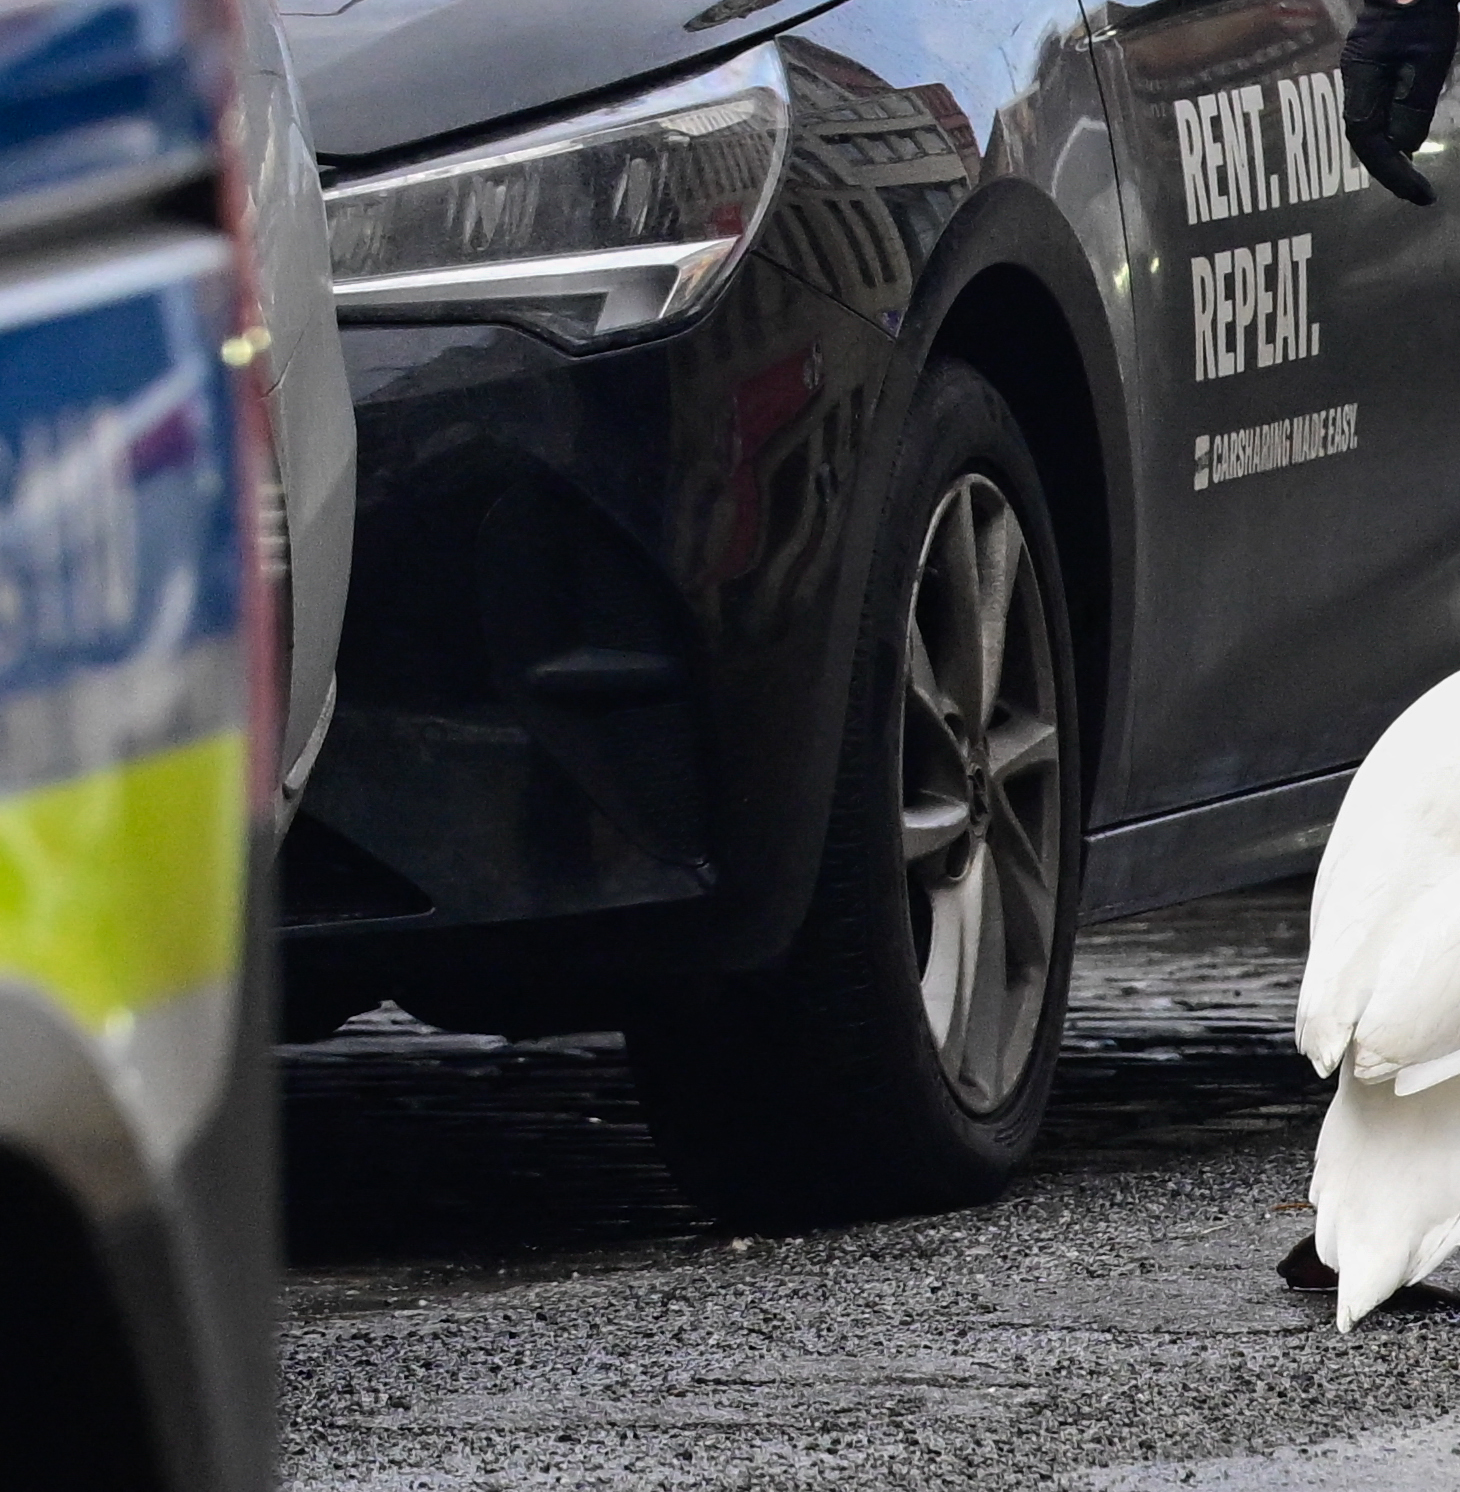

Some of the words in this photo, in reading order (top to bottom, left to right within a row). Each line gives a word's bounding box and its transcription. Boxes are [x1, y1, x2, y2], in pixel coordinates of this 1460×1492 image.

[1174, 84, 1281, 226] RENT.
[1190, 232, 1321, 383] REPEAT.
[1212, 418, 1291, 484] CARSHARING
[1291, 410, 1328, 465] MADE
[1326, 402, 1359, 456] EASY.
